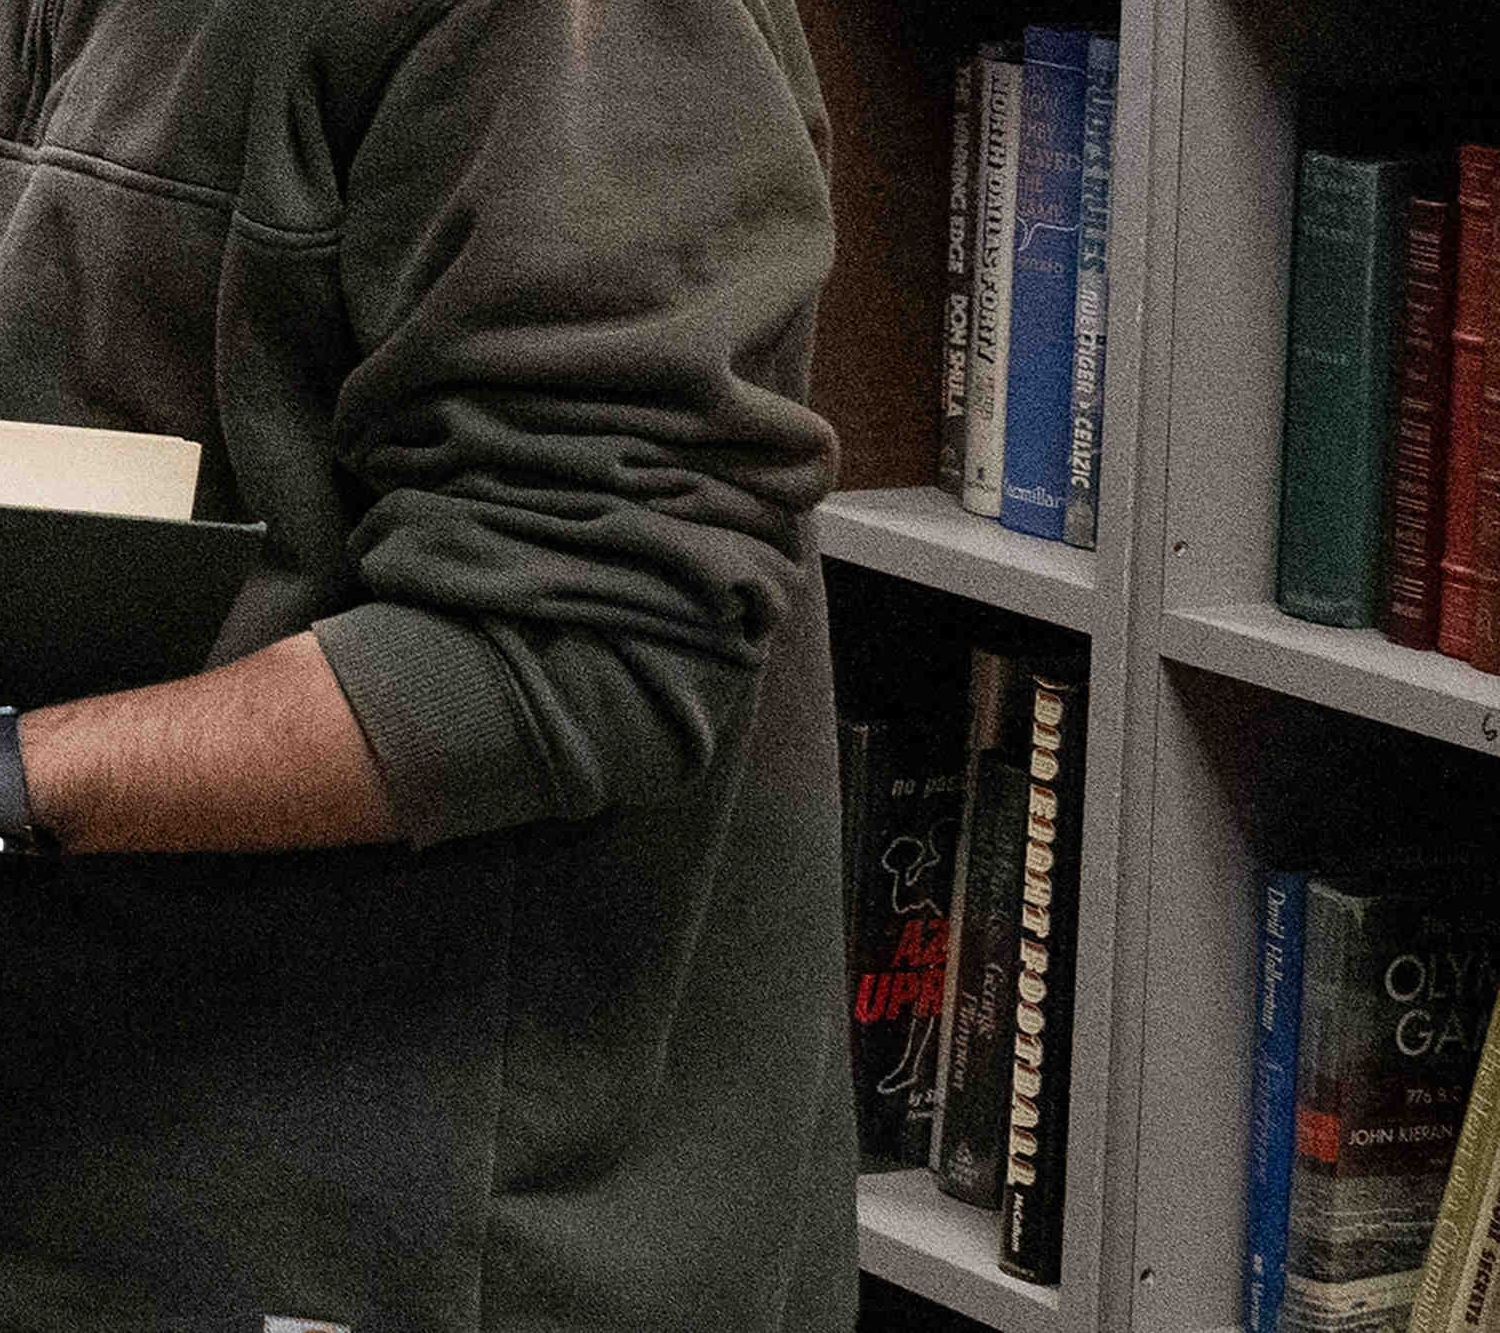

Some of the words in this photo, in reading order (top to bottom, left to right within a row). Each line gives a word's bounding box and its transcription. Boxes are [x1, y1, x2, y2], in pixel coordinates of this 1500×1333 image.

[950, 113, 970, 210] WINNING
[948, 215, 967, 274] EDGE
[948, 293, 968, 346] DON
[945, 350, 967, 417] SHULA
[1069, 415, 1093, 489] CELIZIC
[1032, 692, 1064, 784] BIG
[1019, 787, 1057, 937] EIGHT
[1266, 886, 1287, 940] David
[1005, 941, 1051, 1188] FOOTBALL
[1348, 1127, 1395, 1147] JOHN
[1465, 1248, 1496, 1326] SECRETS
